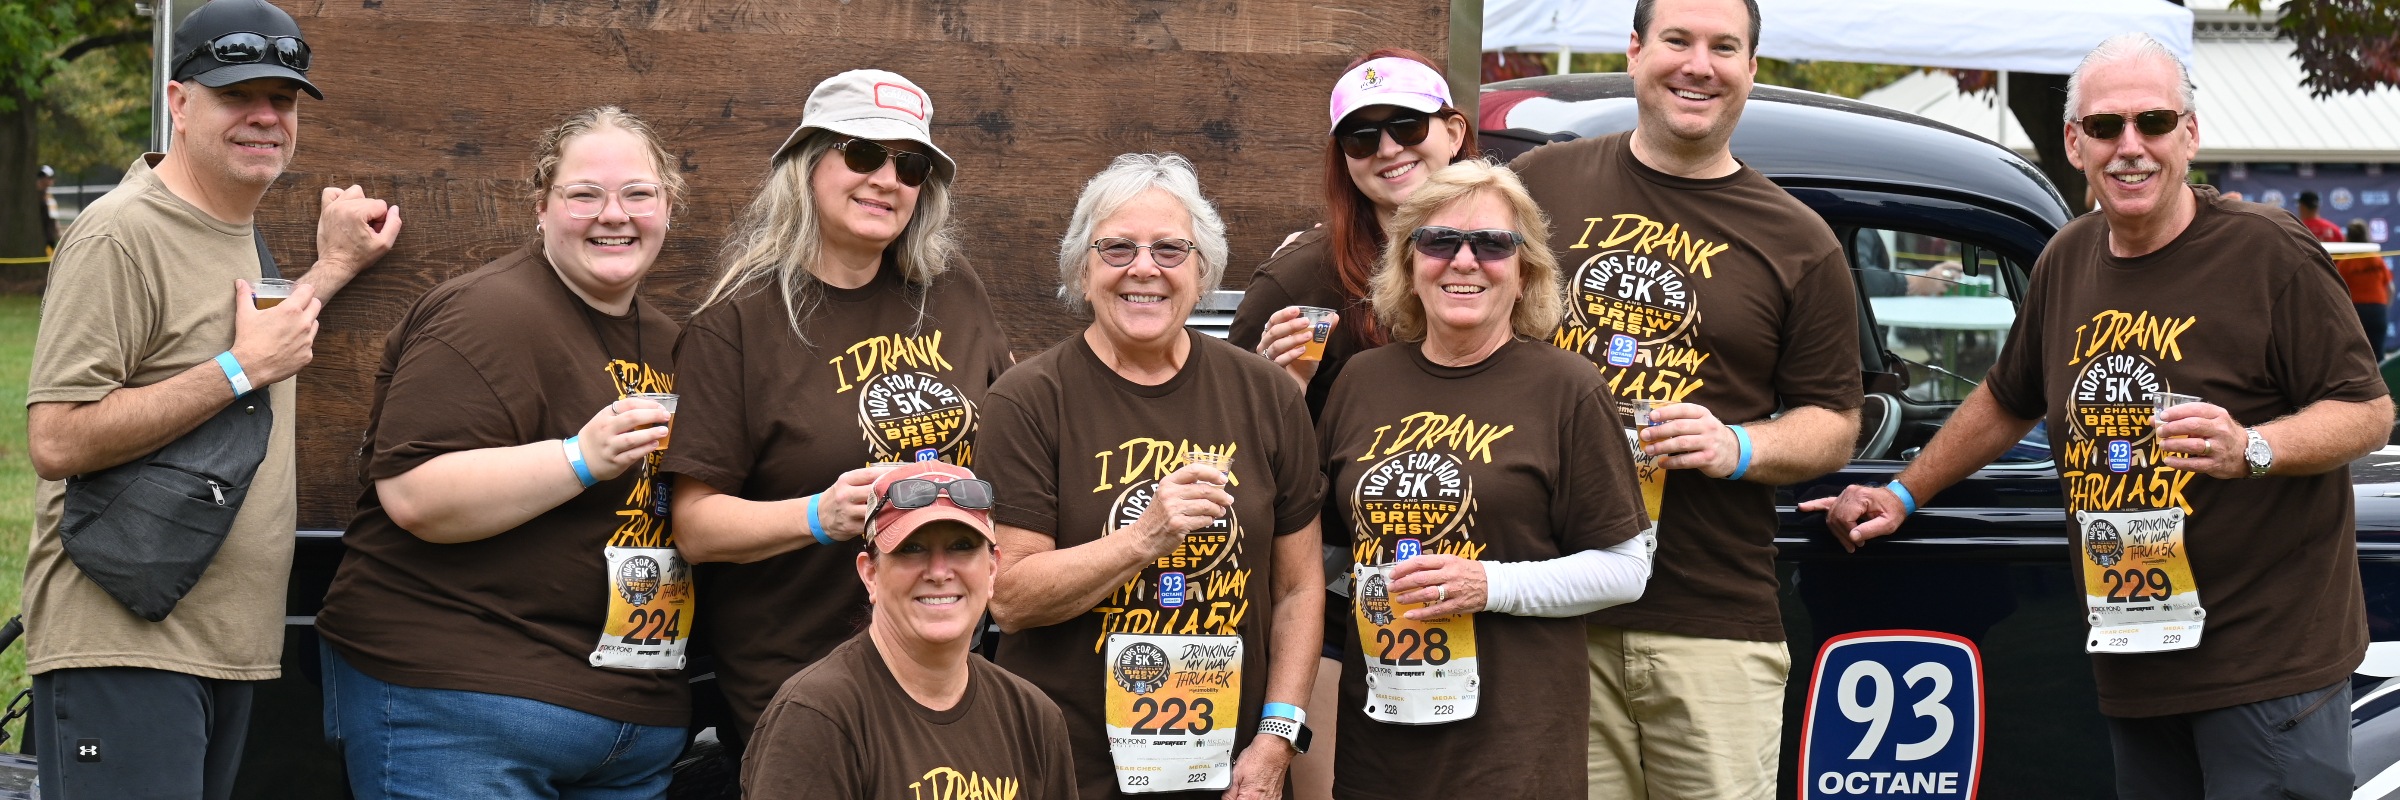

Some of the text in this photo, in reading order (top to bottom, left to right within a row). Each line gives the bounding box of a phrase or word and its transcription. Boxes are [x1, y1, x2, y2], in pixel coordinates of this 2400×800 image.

[1569, 213, 1729, 279] I DRANK
[1584, 255, 1686, 309] HOPS FOR HOPE
[1618, 274, 1656, 303] 5K
[1584, 294, 1682, 321] ST. CHARLES
[1587, 303, 1673, 330] BREW
[1599, 317, 1657, 338] FEST
[2068, 310, 2196, 365] I DRANK
[1553, 327, 1710, 375] MY WAY
[1614, 337, 1633, 353] 93
[829, 329, 953, 394] I DRANK
[2078, 355, 2160, 401] HOPS FOR HOPE
[867, 374, 960, 417] HOPS FOR HOPE
[2105, 377, 2133, 403] 5K
[892, 390, 933, 415] 5K
[878, 408, 964, 429] ST. CHARLES
[885, 416, 961, 441] BREW
[2085, 415, 2151, 426] BREW
[900, 430, 950, 450] FEST
[1357, 412, 1514, 464] I DRANK
[2096, 426, 2142, 436] FEST
[2065, 439, 2095, 468] MY
[2111, 443, 2128, 458] 93
[1093, 451, 1113, 493] I
[1364, 452, 1461, 498] HOPS FOR HOPE
[1640, 466, 1658, 483] 5K
[1396, 473, 1433, 498] 5K
[2064, 466, 2196, 515] THRU A 5K
[1393, 503, 1457, 511] CHARLES
[1371, 511, 1449, 524] BREW
[2127, 516, 2177, 535] DRINKING
[1184, 535, 1226, 543] RLES
[1383, 524, 1434, 535] FEST
[2089, 522, 2116, 540] HOPS FOR HOPE
[2097, 531, 2107, 540] 5K
[2134, 529, 2172, 544] MY WAY
[1172, 544, 1218, 556] EW
[1400, 542, 1418, 558] 93
[1437, 539, 1486, 561] WAY
[2127, 545, 2153, 560] THRU
[2161, 542, 2176, 558] 5K
[635, 559, 649, 567] FOR
[635, 568, 648, 577] 5K
[1163, 576, 1182, 592] 93
[1207, 568, 1252, 600] WAY
[1375, 586, 1384, 596] 5K
[2103, 568, 2172, 603] 229
[1204, 599, 1248, 635] 5K
[621, 609, 681, 646] 224
[1377, 628, 1450, 666] 228
[2109, 638, 2128, 647] 229
[2163, 635, 2181, 644] 229
[1122, 645, 1163, 666] HOPS FOR HOPE
[1136, 655, 1150, 665] 5K
[1180, 643, 1237, 660] DRINKING
[1185, 658, 1230, 671] MY WAY
[1175, 671, 1233, 688] THRU A 5K
[1131, 697, 1214, 735] 223
[1385, 704, 1397, 715] 228
[1434, 705, 1454, 715] 228
[1837, 659, 1955, 761] 93
[1128, 776, 1149, 785] 223
[1187, 773, 1207, 783] 223
[1818, 771, 1959, 795] OCTANE
